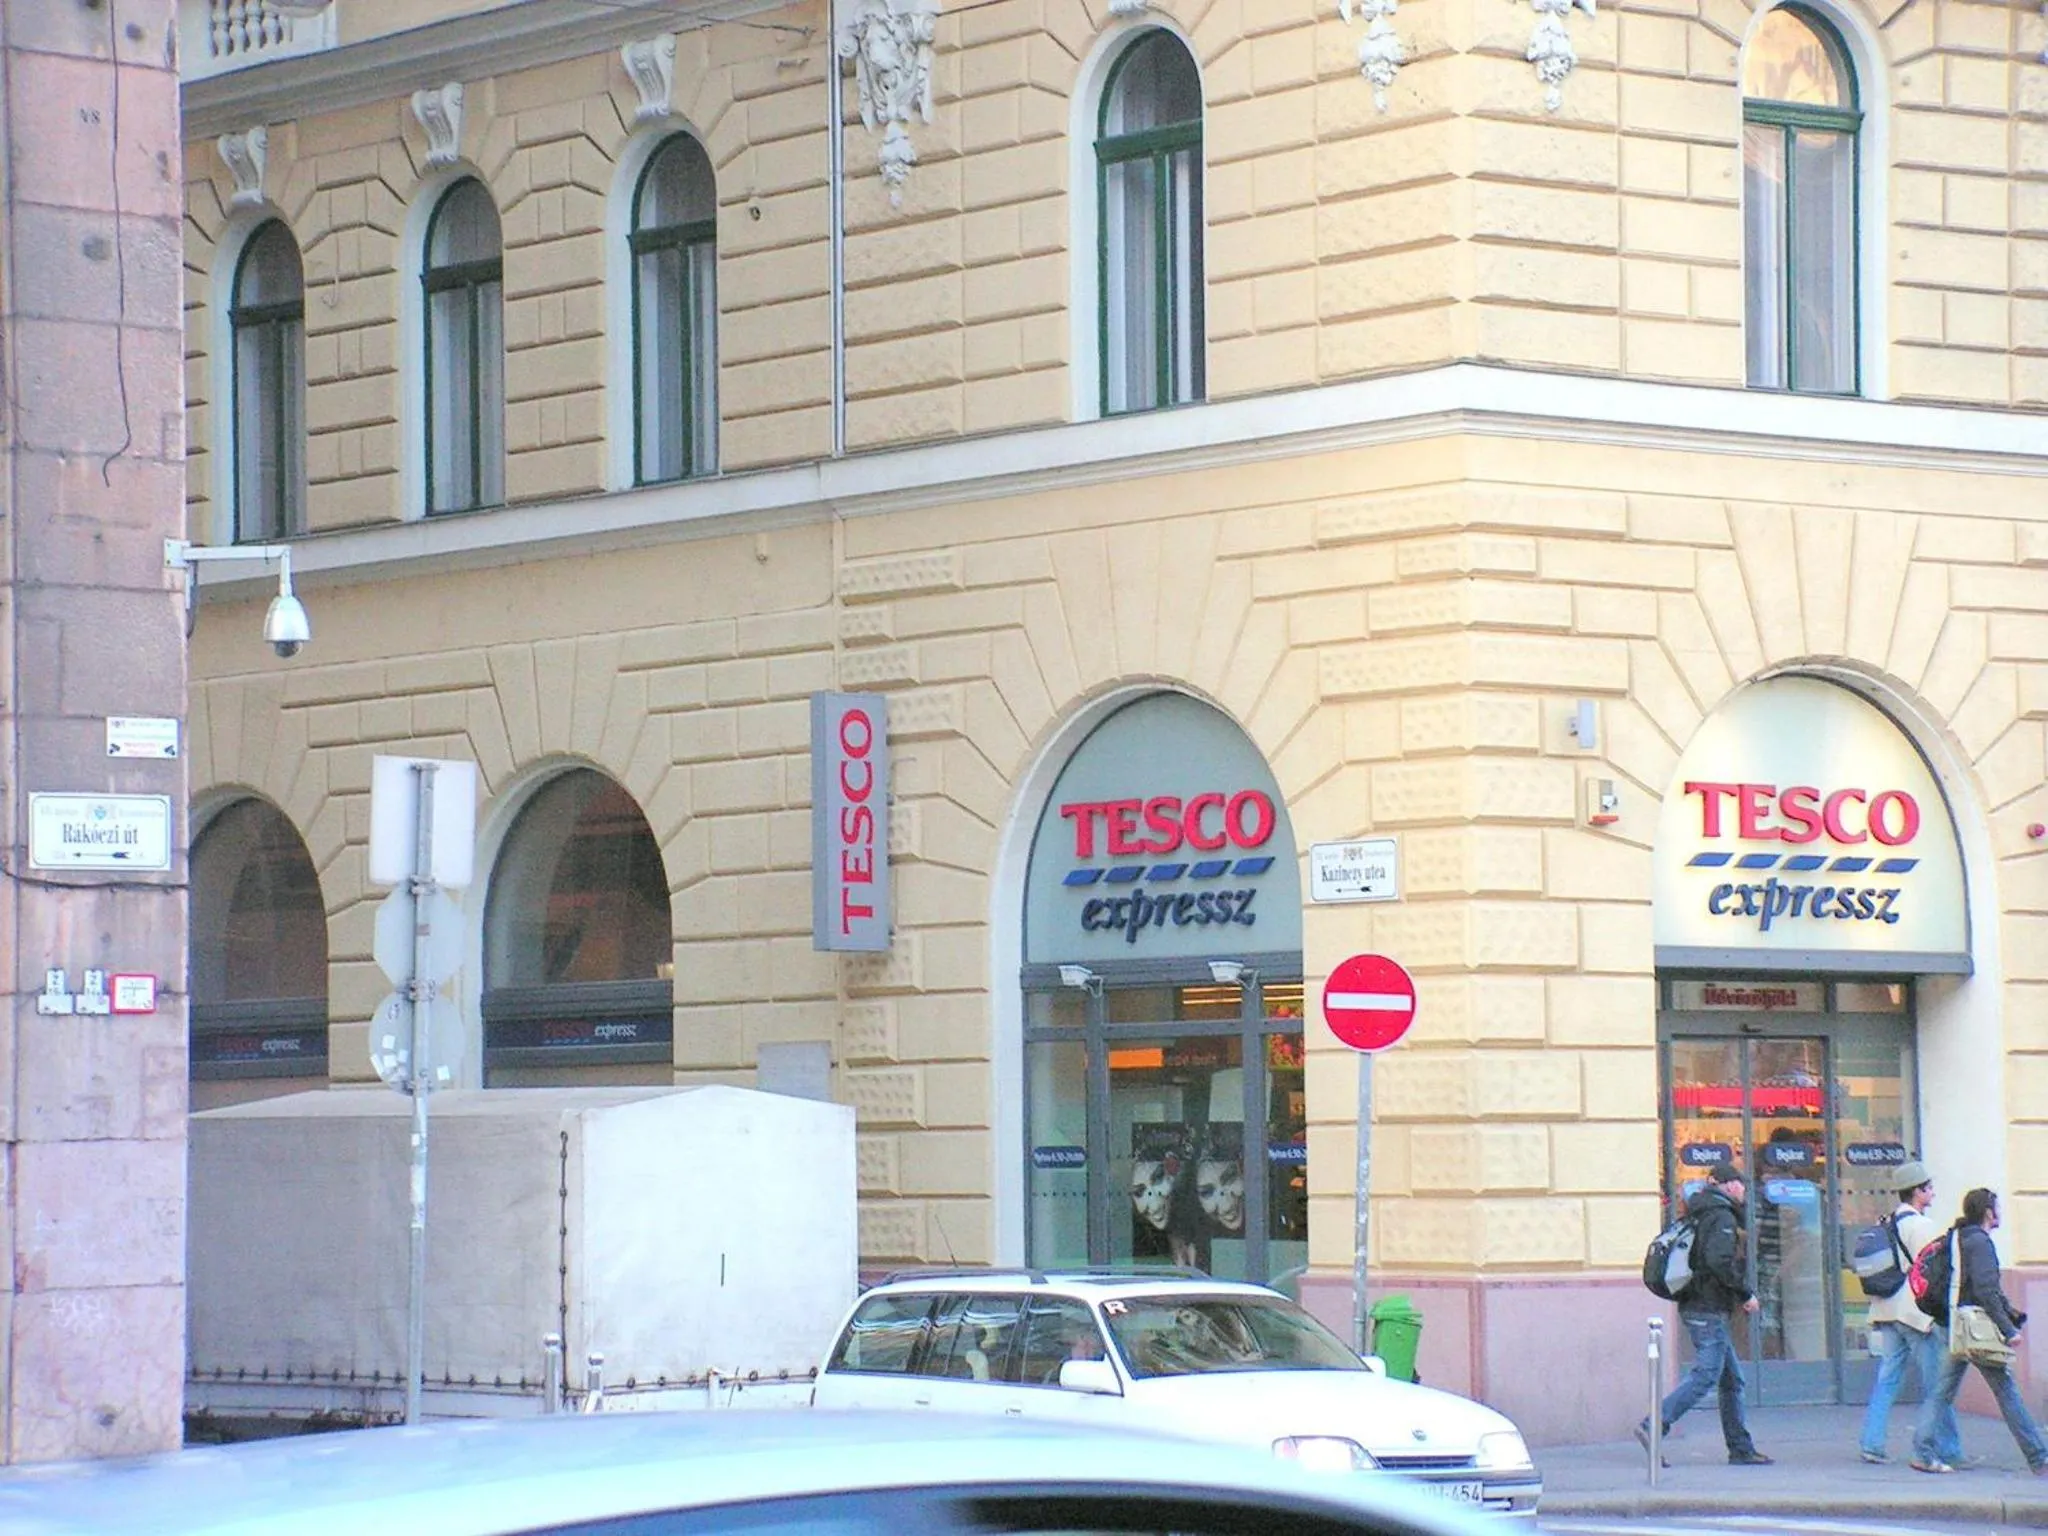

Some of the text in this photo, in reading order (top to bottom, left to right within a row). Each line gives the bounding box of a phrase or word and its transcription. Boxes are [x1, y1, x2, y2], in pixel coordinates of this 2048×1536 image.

[62, 822, 139, 844] Rákóczi út
[839, 708, 875, 935] TESCO
[1060, 789, 1277, 858] TESCO
[1684, 781, 1921, 846] TESCO
[1080, 888, 1257, 944] expressz
[1708, 876, 1902, 932] expressz
